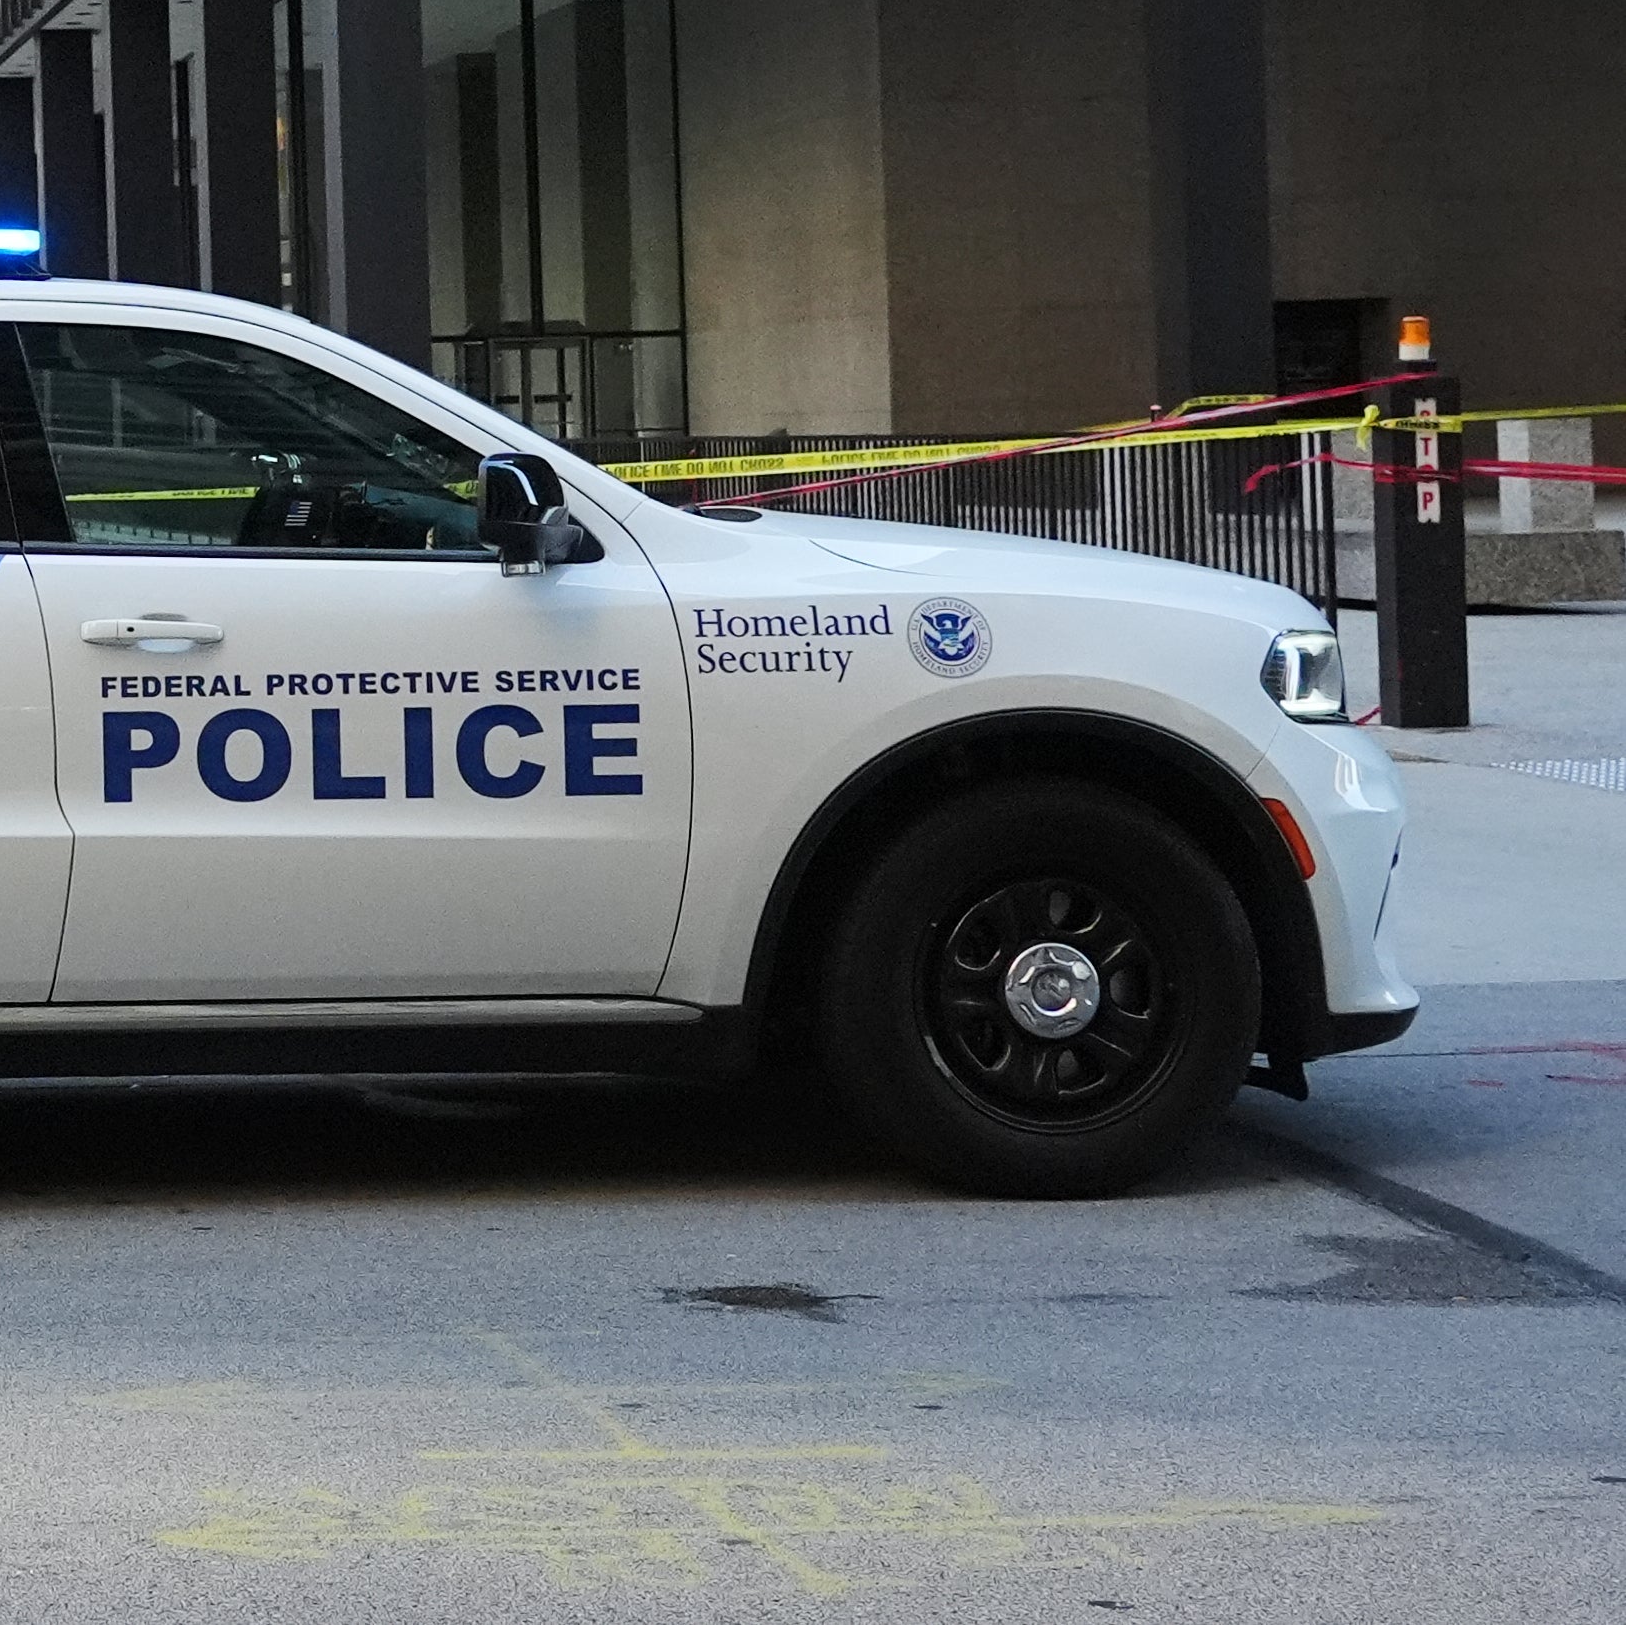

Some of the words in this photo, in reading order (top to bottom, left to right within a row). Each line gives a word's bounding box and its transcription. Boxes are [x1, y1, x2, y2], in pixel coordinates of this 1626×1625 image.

[693, 603, 894, 639] Homeland
[697, 642, 854, 683] Security
[101, 675, 253, 699] FEDERAL
[266, 671, 481, 697] PROTECTIVE
[495, 669, 641, 693] SERVICE
[102, 704, 644, 804] POLICE
